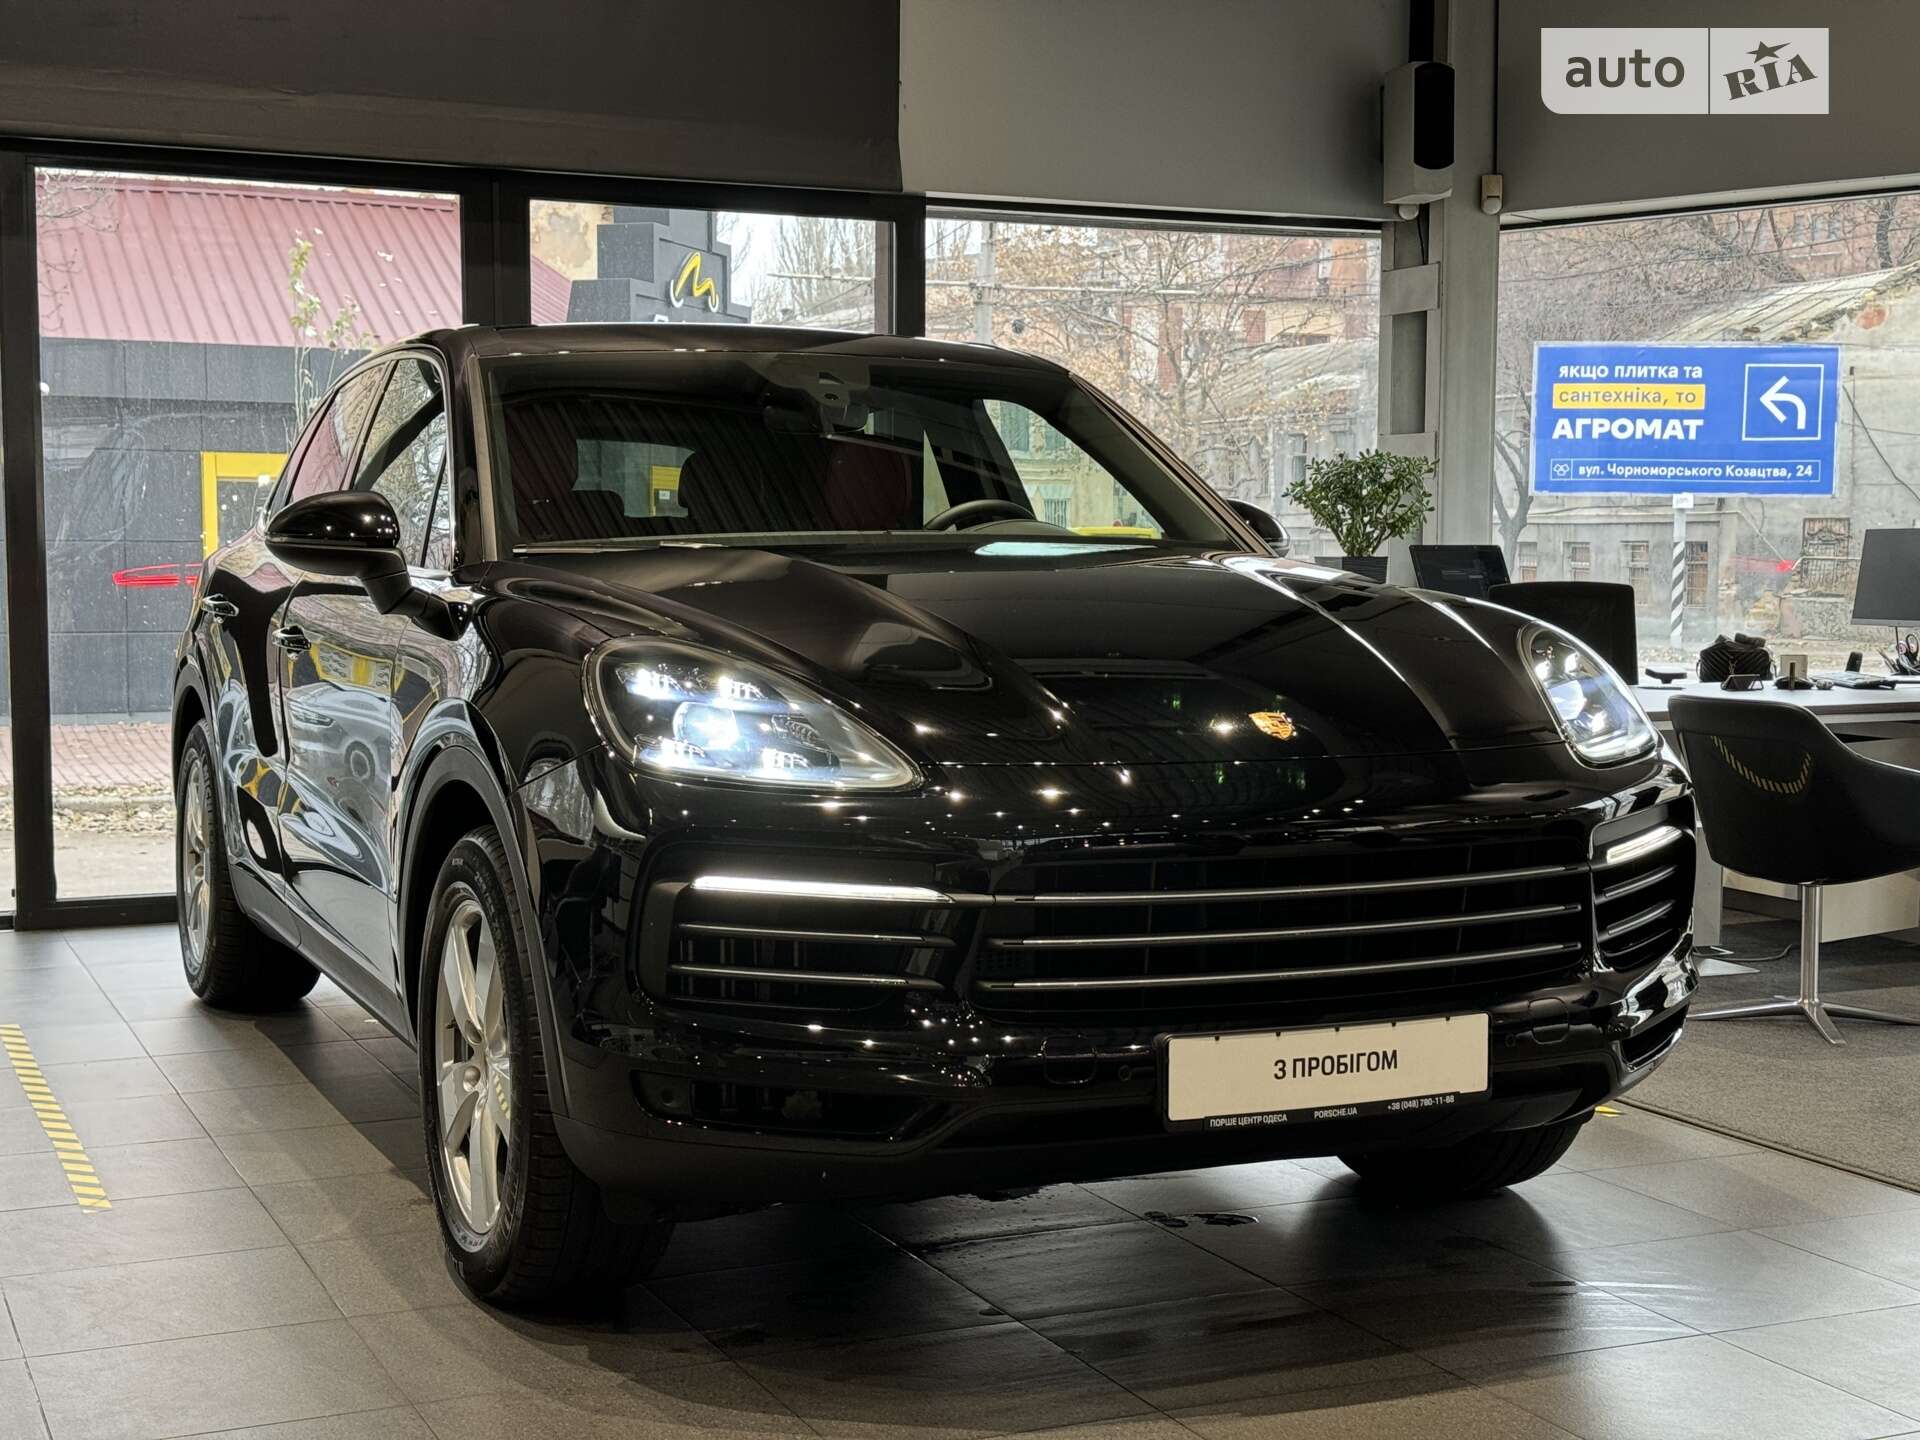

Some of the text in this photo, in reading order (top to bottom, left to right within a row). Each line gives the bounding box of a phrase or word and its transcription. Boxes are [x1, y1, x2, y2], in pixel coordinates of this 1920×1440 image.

[1559, 365, 1703, 381] якщо плитка та
[1559, 387, 1696, 406] сантехніка, то
[1552, 417, 1704, 440] АГРОМАТ
[1578, 463, 1813, 479] вул. Чорноморського Козацтва, 24
[1293, 1049, 1398, 1078] ПРОБІГОМ
[1210, 1113, 1288, 1127] ПОРШЕ ЦЕНТР ОДЕСА
[1313, 1106, 1358, 1119] PORSCHE.UA
